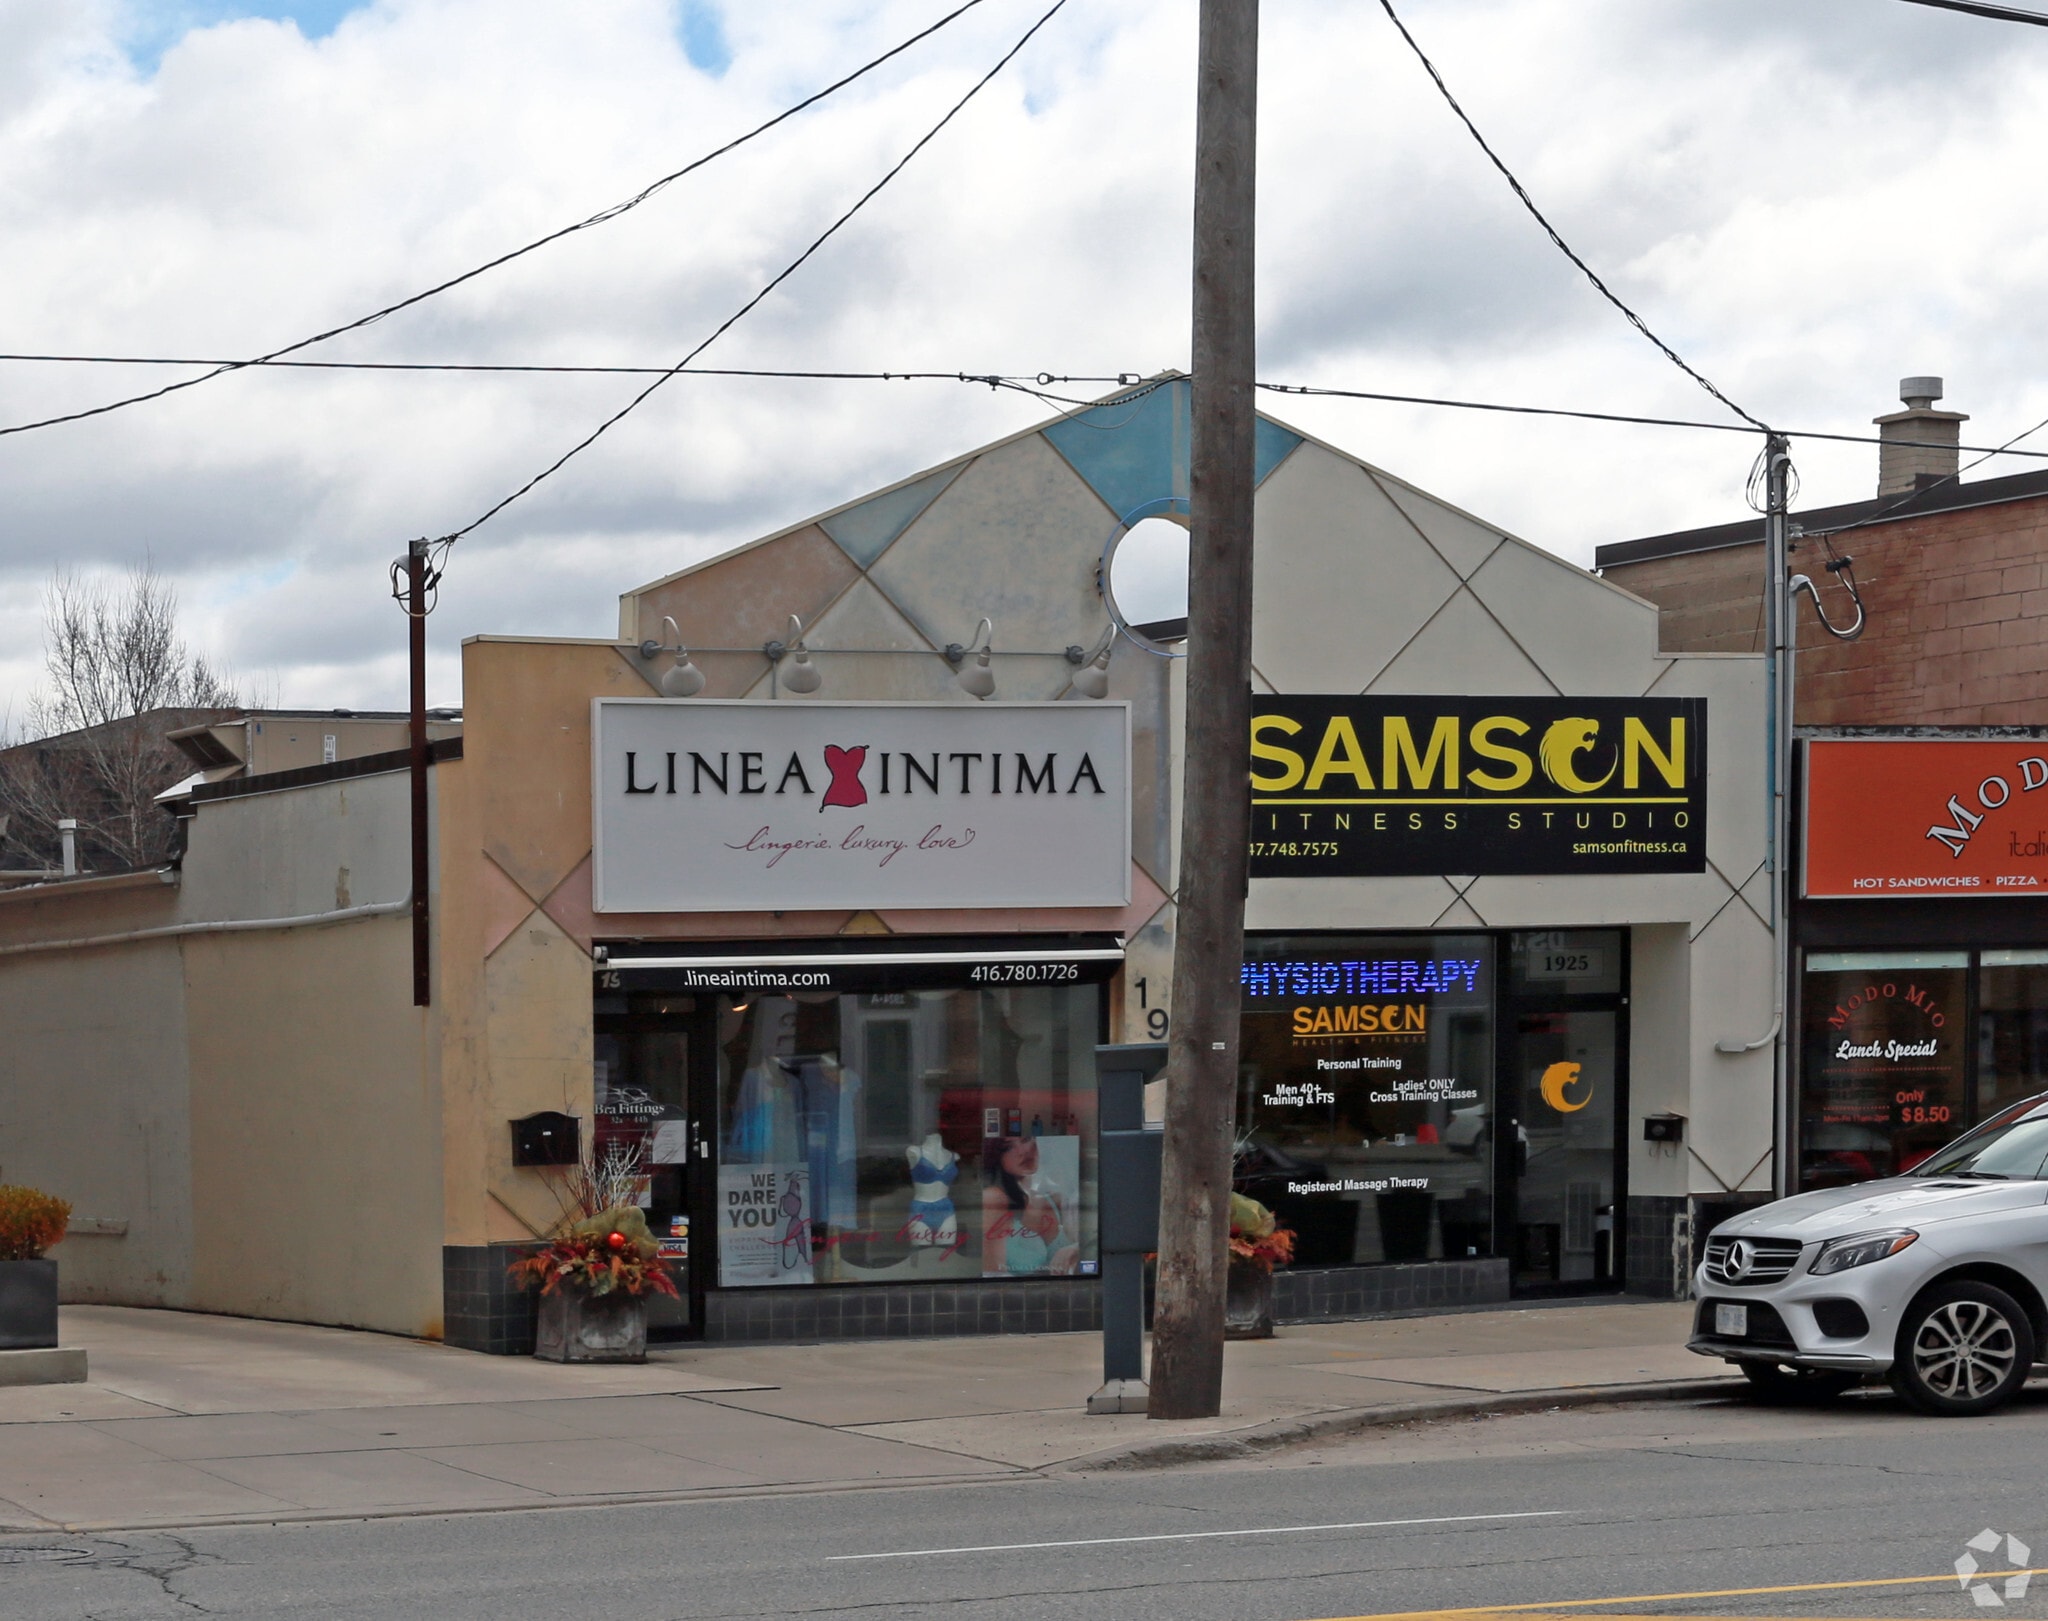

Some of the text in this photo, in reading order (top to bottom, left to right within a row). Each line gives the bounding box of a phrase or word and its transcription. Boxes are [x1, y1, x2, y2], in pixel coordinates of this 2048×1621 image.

[625, 751, 1106, 794] LINEA INTIMA
[1271, 811, 1689, 831] ITNESS STUDIO
[1249, 839, 1688, 857] 47.748.7575 samsonfitness.ca
[2009, 830, 2048, 858] itali
[1853, 875, 2038, 889] HOT SANDWICHES PIZZA
[1544, 955, 1589, 972] 1925
[970, 963, 1079, 982] 416.780.1726
[1826, 982, 1946, 1031] MODO MIO
[1292, 1038, 1344, 1048] HEALTH
[1371, 1036, 1427, 1045] FITNESS
[1835, 1038, 1938, 1062] Lunch Special
[1317, 1056, 1402, 1071] Personal Training
[1276, 1083, 1322, 1096] Men 40+
[1429, 1078, 1456, 1090] ONLY
[1263, 1092, 1335, 1107] Training & FTS
[1370, 1088, 1477, 1103] Cross Training Classes
[1896, 1089, 1925, 1104] Only
[619, 1103, 665, 1116] Fittings
[751, 1173, 776, 1188] WE
[1288, 1176, 1429, 1195] Registered Massage Therapy
[728, 1189, 777, 1206] DARE
[727, 1207, 777, 1228] YOU
